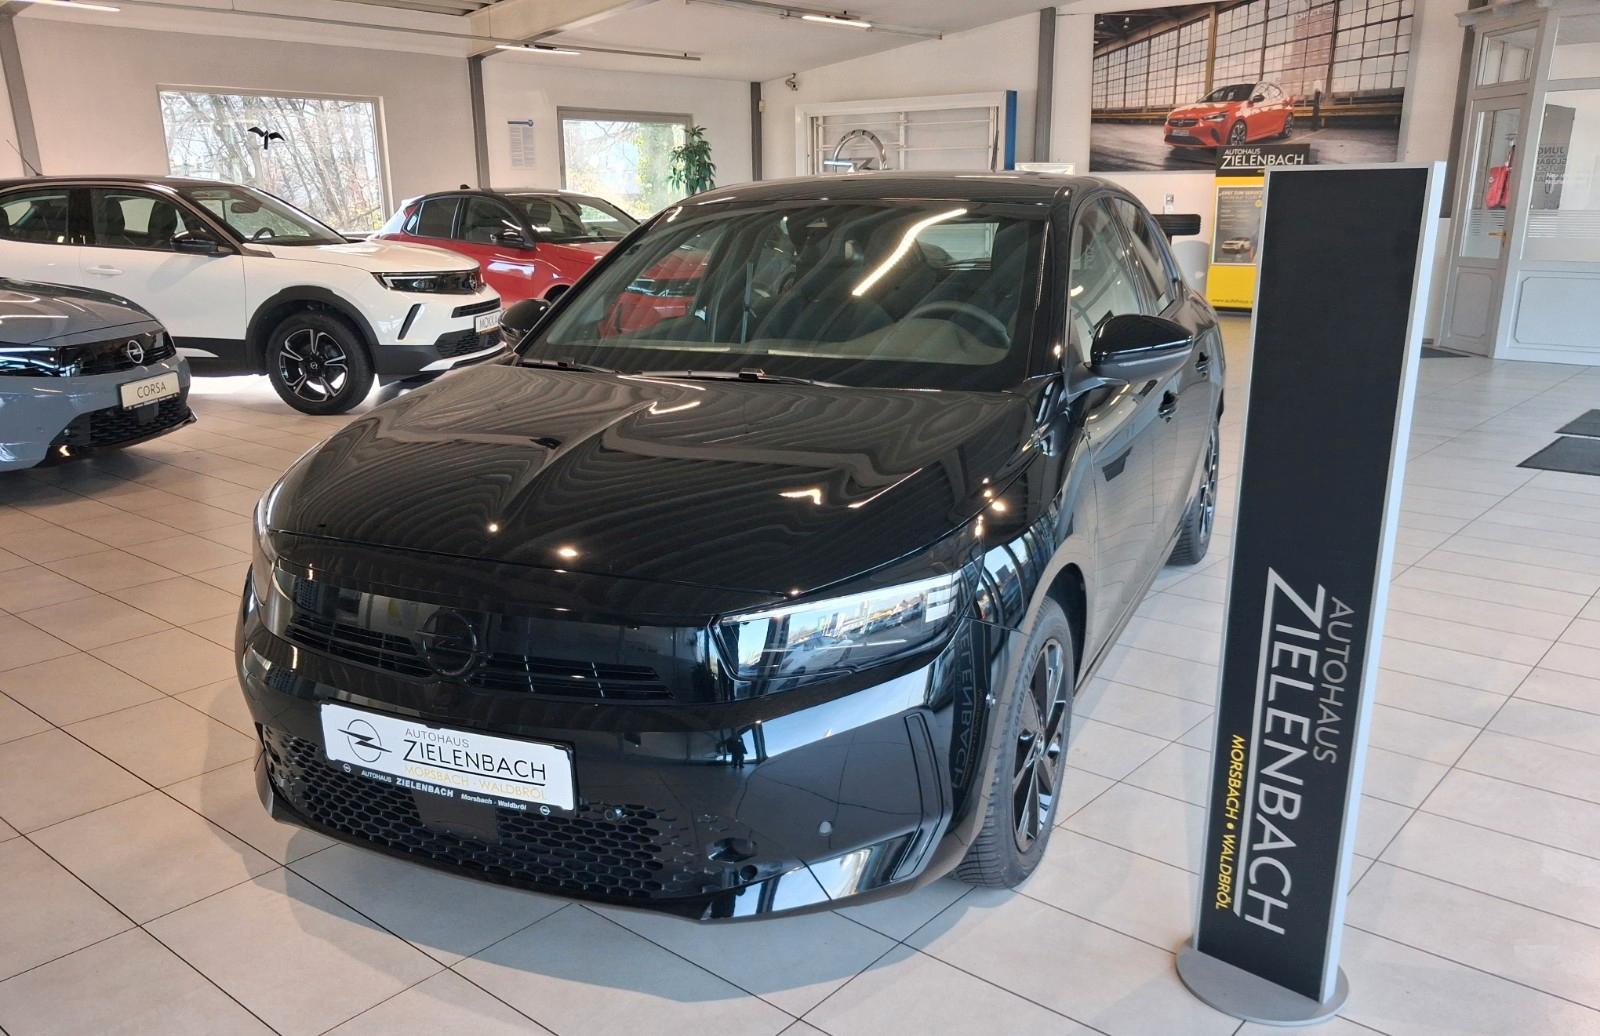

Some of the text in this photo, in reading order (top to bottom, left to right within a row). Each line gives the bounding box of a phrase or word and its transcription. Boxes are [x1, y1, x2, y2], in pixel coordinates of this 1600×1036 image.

[1220, 154, 1304, 169] ZIELENBACH
[136, 381, 167, 398] CORSA
[1313, 596, 1355, 764] AUTOHAUS
[405, 728, 470, 748] AUTOHAUS
[1242, 566, 1327, 935] ZIELENBACH
[402, 738, 547, 783] ZIELENBACH
[404, 765, 470, 786] MORSBACH
[361, 769, 527, 810] AUTOHAUS ZIELENBACH Morsbach Waldbröl
[1215, 734, 1246, 910] MORSBACH WALDBRÖL
